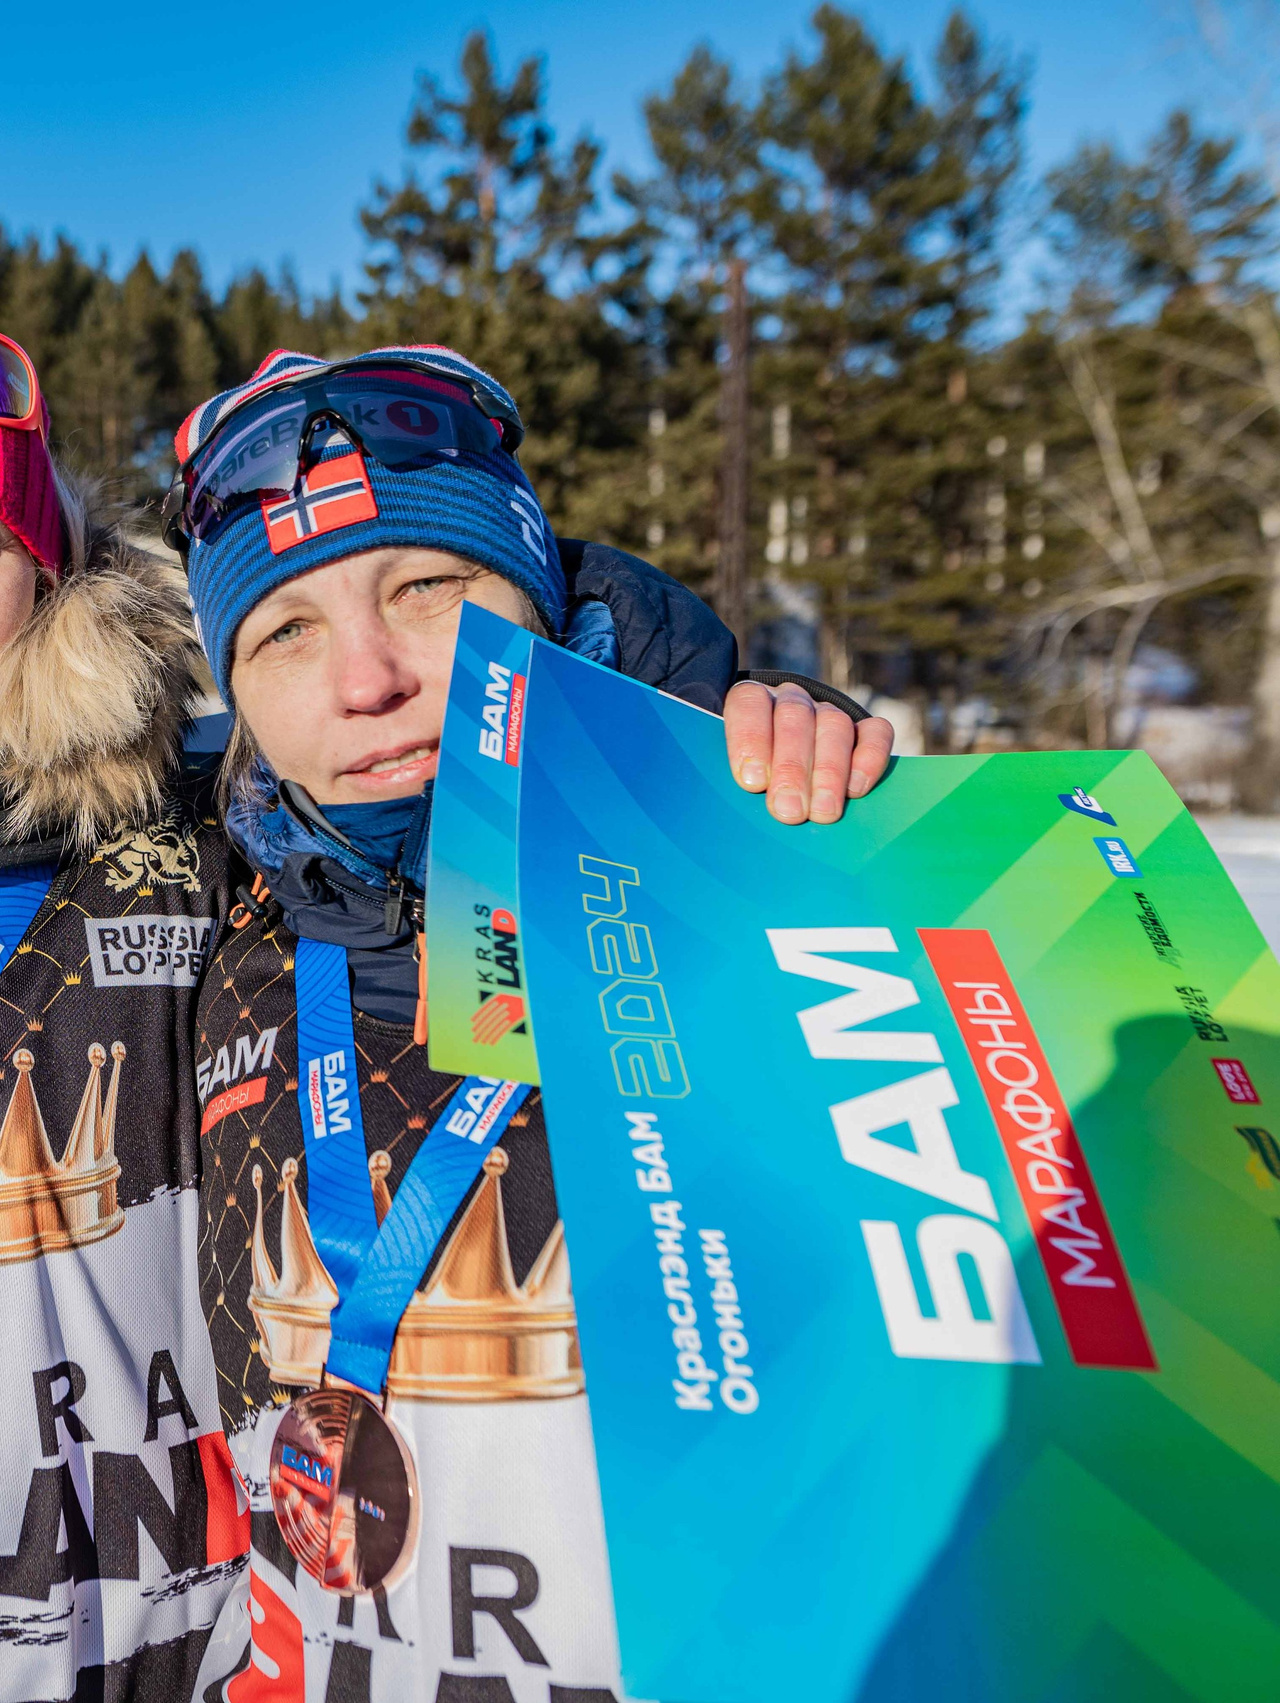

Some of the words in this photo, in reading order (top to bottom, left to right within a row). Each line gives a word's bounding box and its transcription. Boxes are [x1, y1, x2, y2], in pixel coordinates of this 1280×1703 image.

[478, 661, 511, 761] БАМ
[507, 688, 523, 753] МАРАФОНЫ
[1106, 840, 1136, 873] IRK.RU
[102, 951, 204, 977] LOPPE
[475, 904, 492, 983] KRAS
[490, 908, 518, 987] LAND
[310, 1070, 323, 1126] МАРАФОНЫ
[323, 1050, 352, 1135] БАМ
[625, 1111, 673, 1192] БАМ
[765, 926, 1043, 1366] БАМ
[952, 981, 1116, 1289] МАРАФОНЫ
[649, 1200, 714, 1411] Краслэнд
[698, 1229, 760, 1415] Огоньки
[281, 1445, 333, 1487] БАМ
